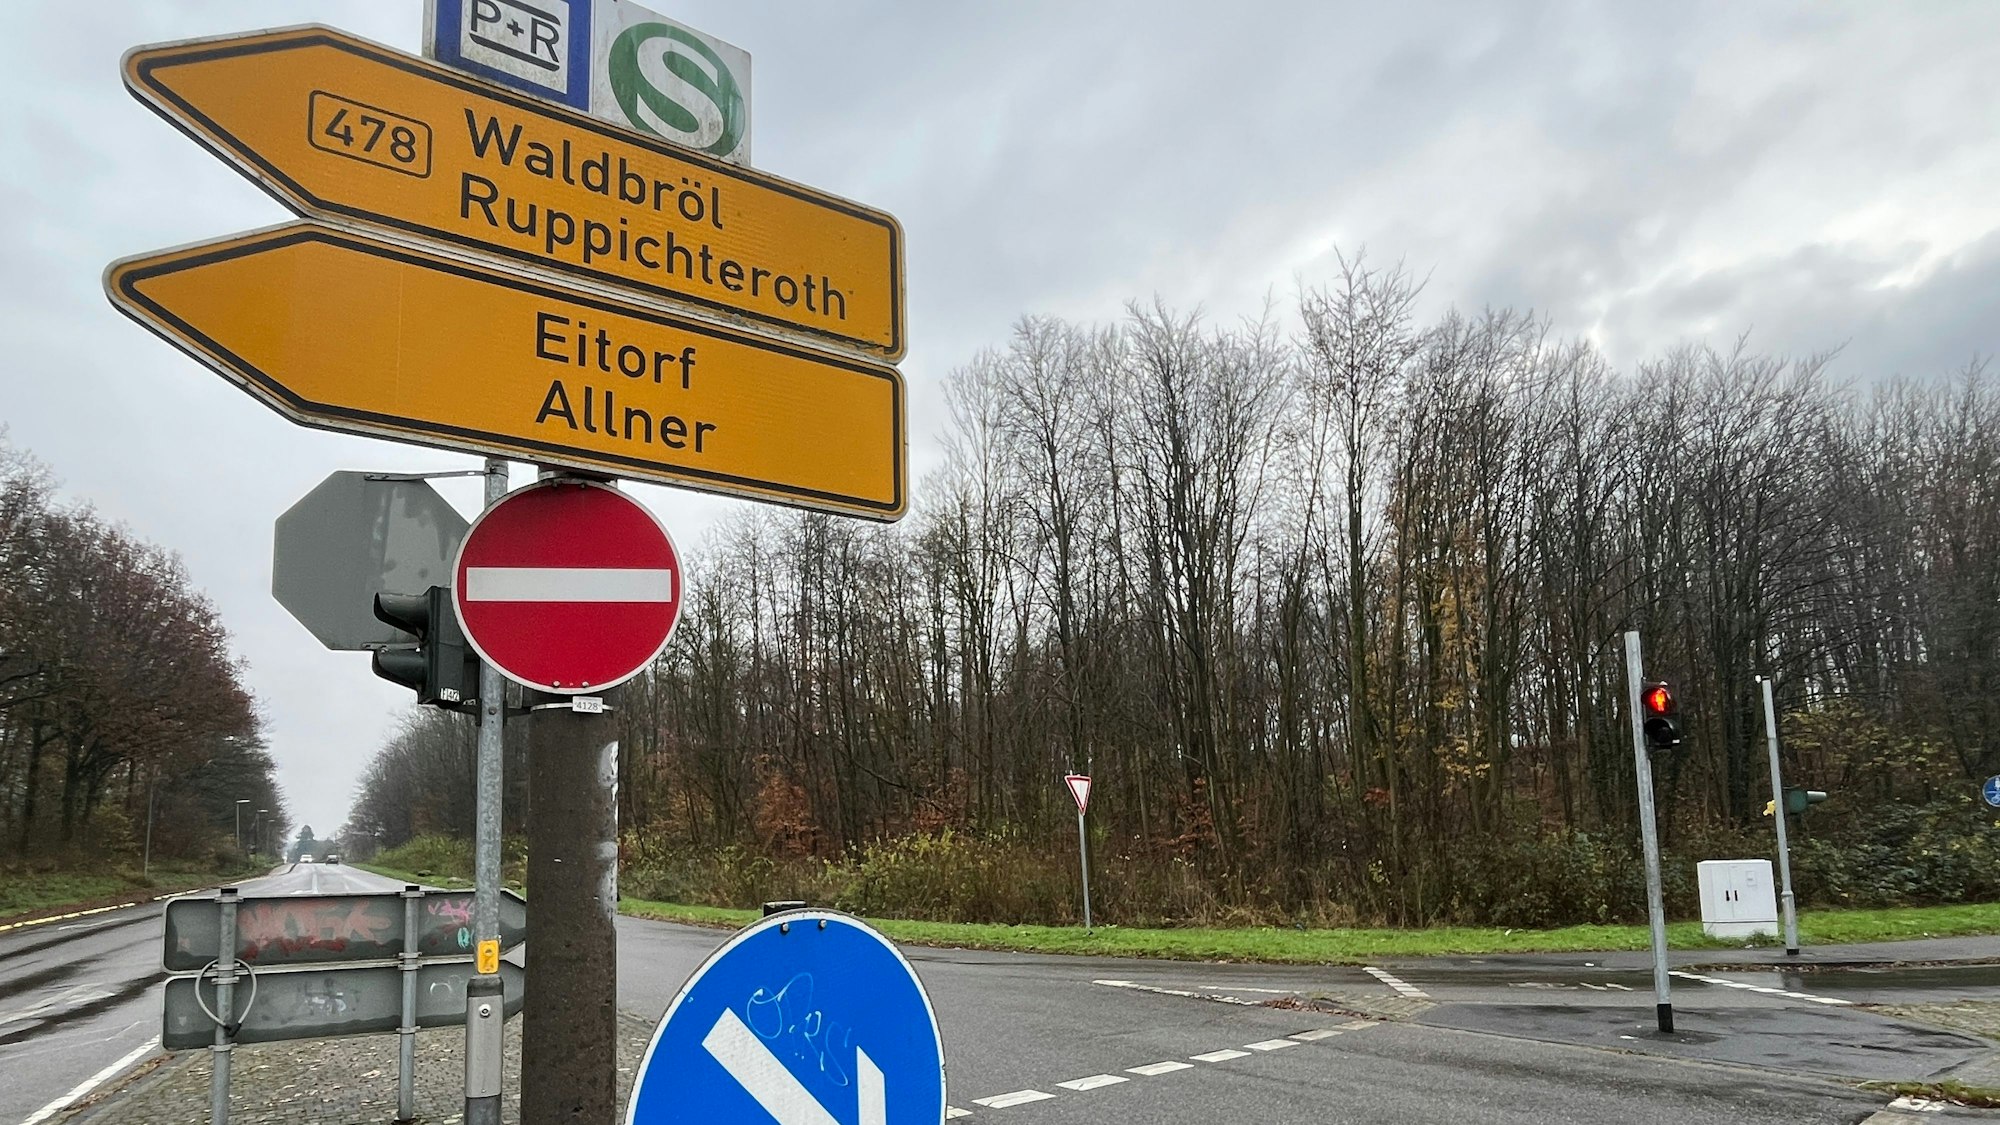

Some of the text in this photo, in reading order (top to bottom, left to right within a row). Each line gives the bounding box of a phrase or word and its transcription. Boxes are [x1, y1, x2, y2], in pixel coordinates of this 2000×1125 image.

[325, 108, 417, 163] 478
[637, 37, 725, 149] S
[464, 108, 723, 229] Waldbröl
[460, 172, 847, 320] Ruppichteroth
[536, 311, 696, 389] Eitorf
[535, 380, 718, 453] Allner
